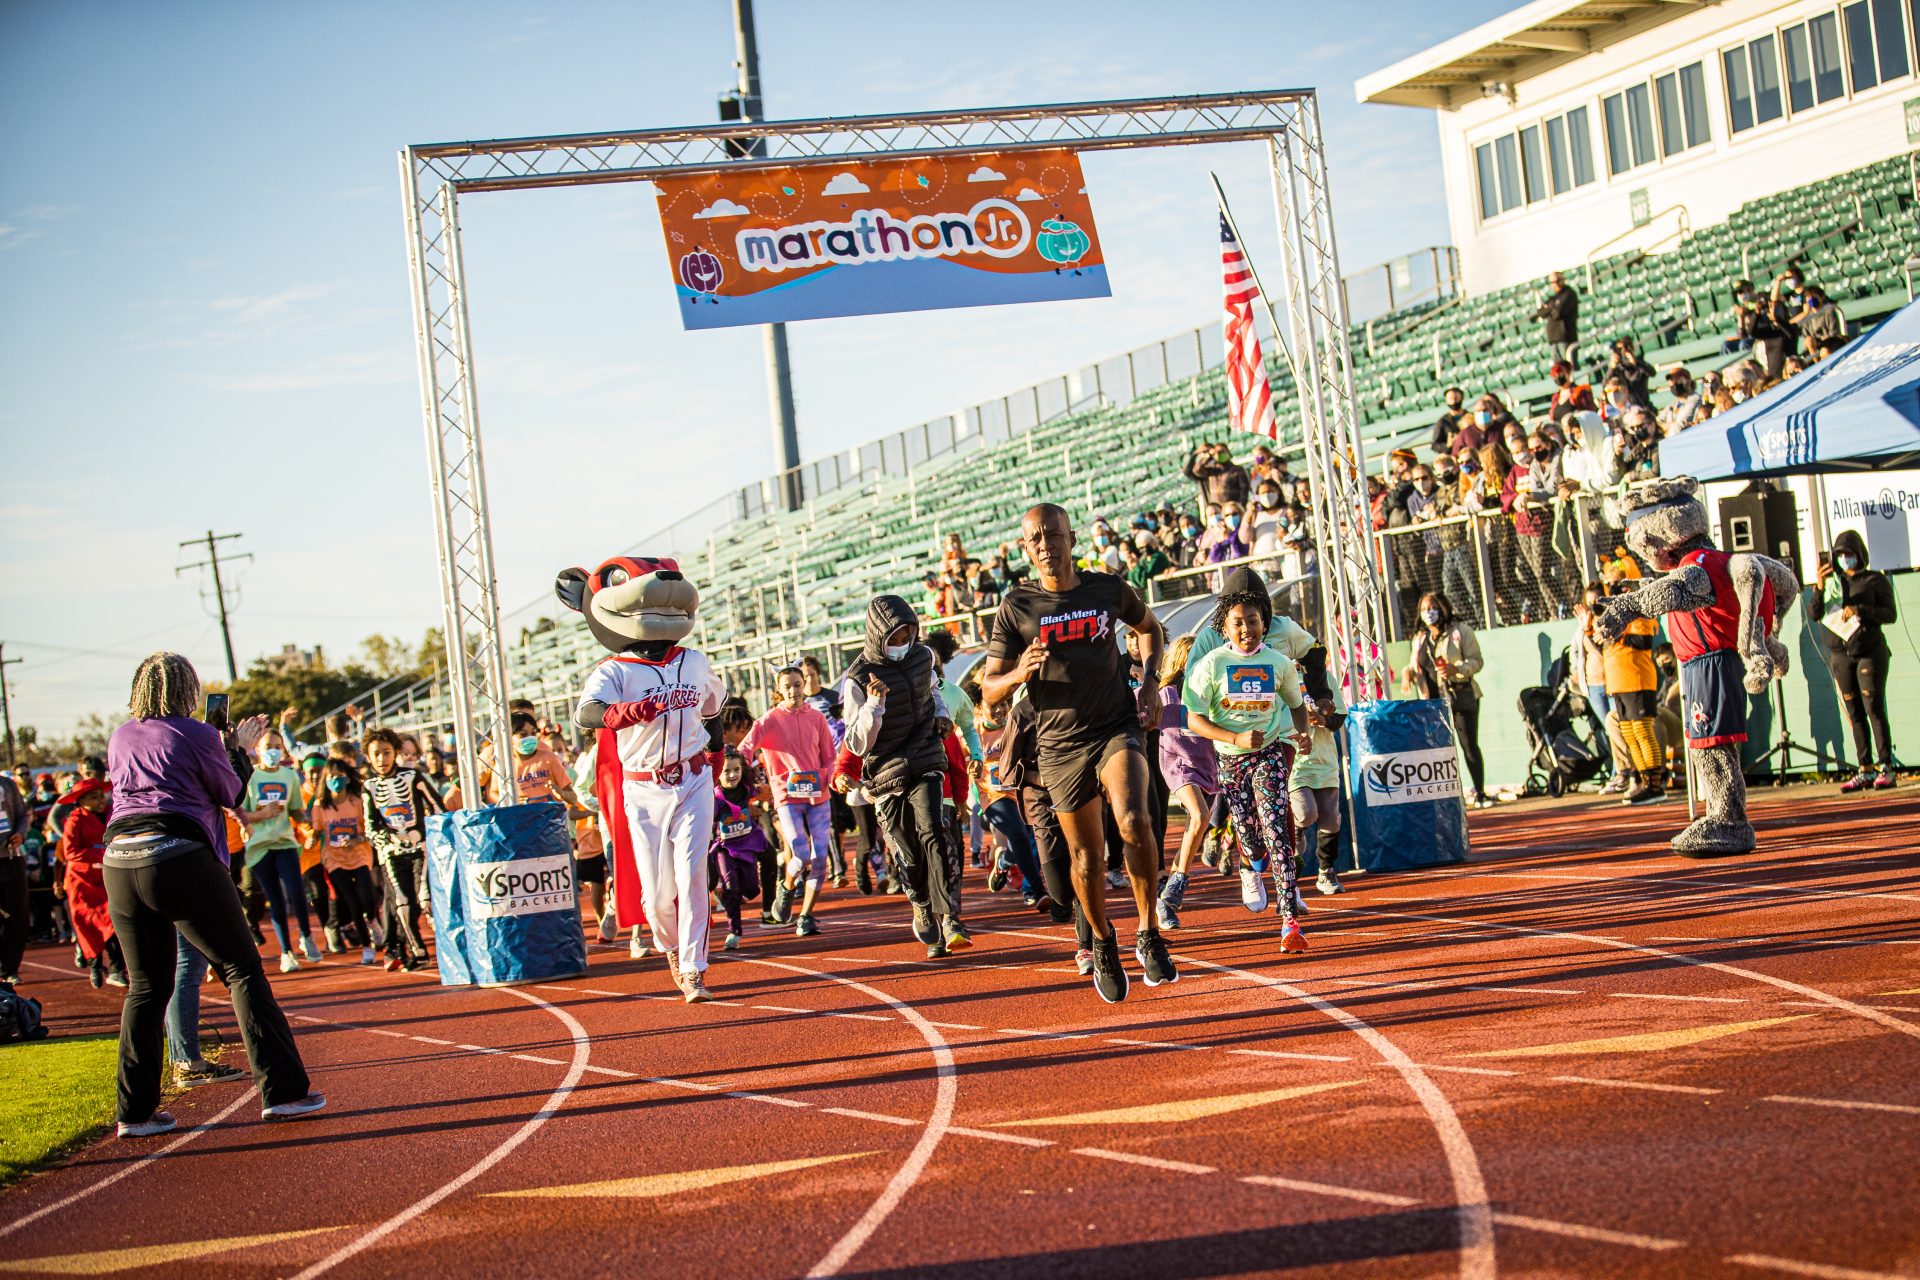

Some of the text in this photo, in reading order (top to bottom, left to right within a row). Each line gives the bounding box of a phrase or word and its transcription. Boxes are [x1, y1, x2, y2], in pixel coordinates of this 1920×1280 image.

[744, 206, 1018, 265] marathon Jr.
[1833, 497, 1877, 520] Allianz
[1040, 616, 1098, 646] run
[1241, 680, 1262, 693] 65
[1390, 756, 1458, 786] SPORTS
[794, 782, 814, 793] 158
[1406, 781, 1460, 796] BACKERS
[727, 821, 745, 833] 110
[494, 865, 571, 898] SPORTS
[510, 893, 572, 909] BACKERS
